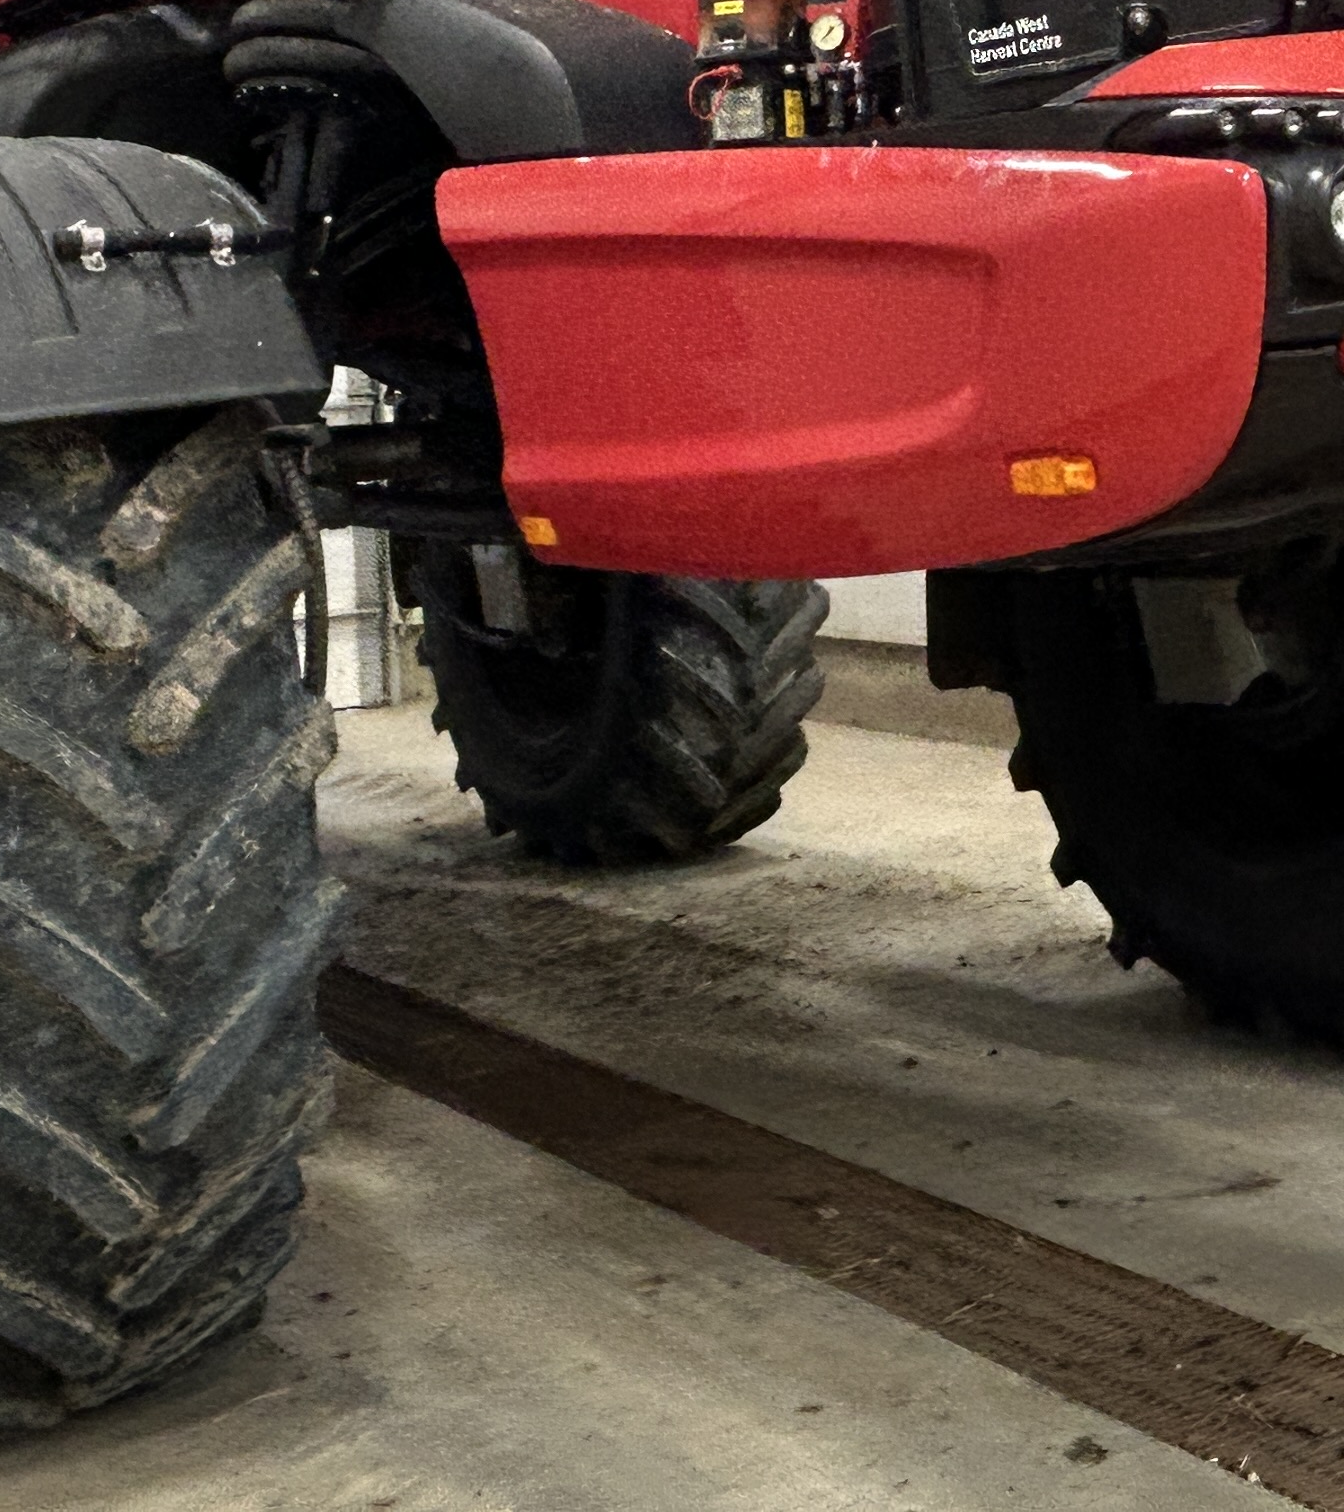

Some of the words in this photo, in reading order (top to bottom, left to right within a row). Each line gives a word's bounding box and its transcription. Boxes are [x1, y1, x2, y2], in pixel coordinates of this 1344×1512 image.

[968, 22, 1015, 45] Canada
[1016, 14, 1049, 34] West
[970, 41, 1019, 65] Harvest
[1019, 35, 1063, 55] Centre
